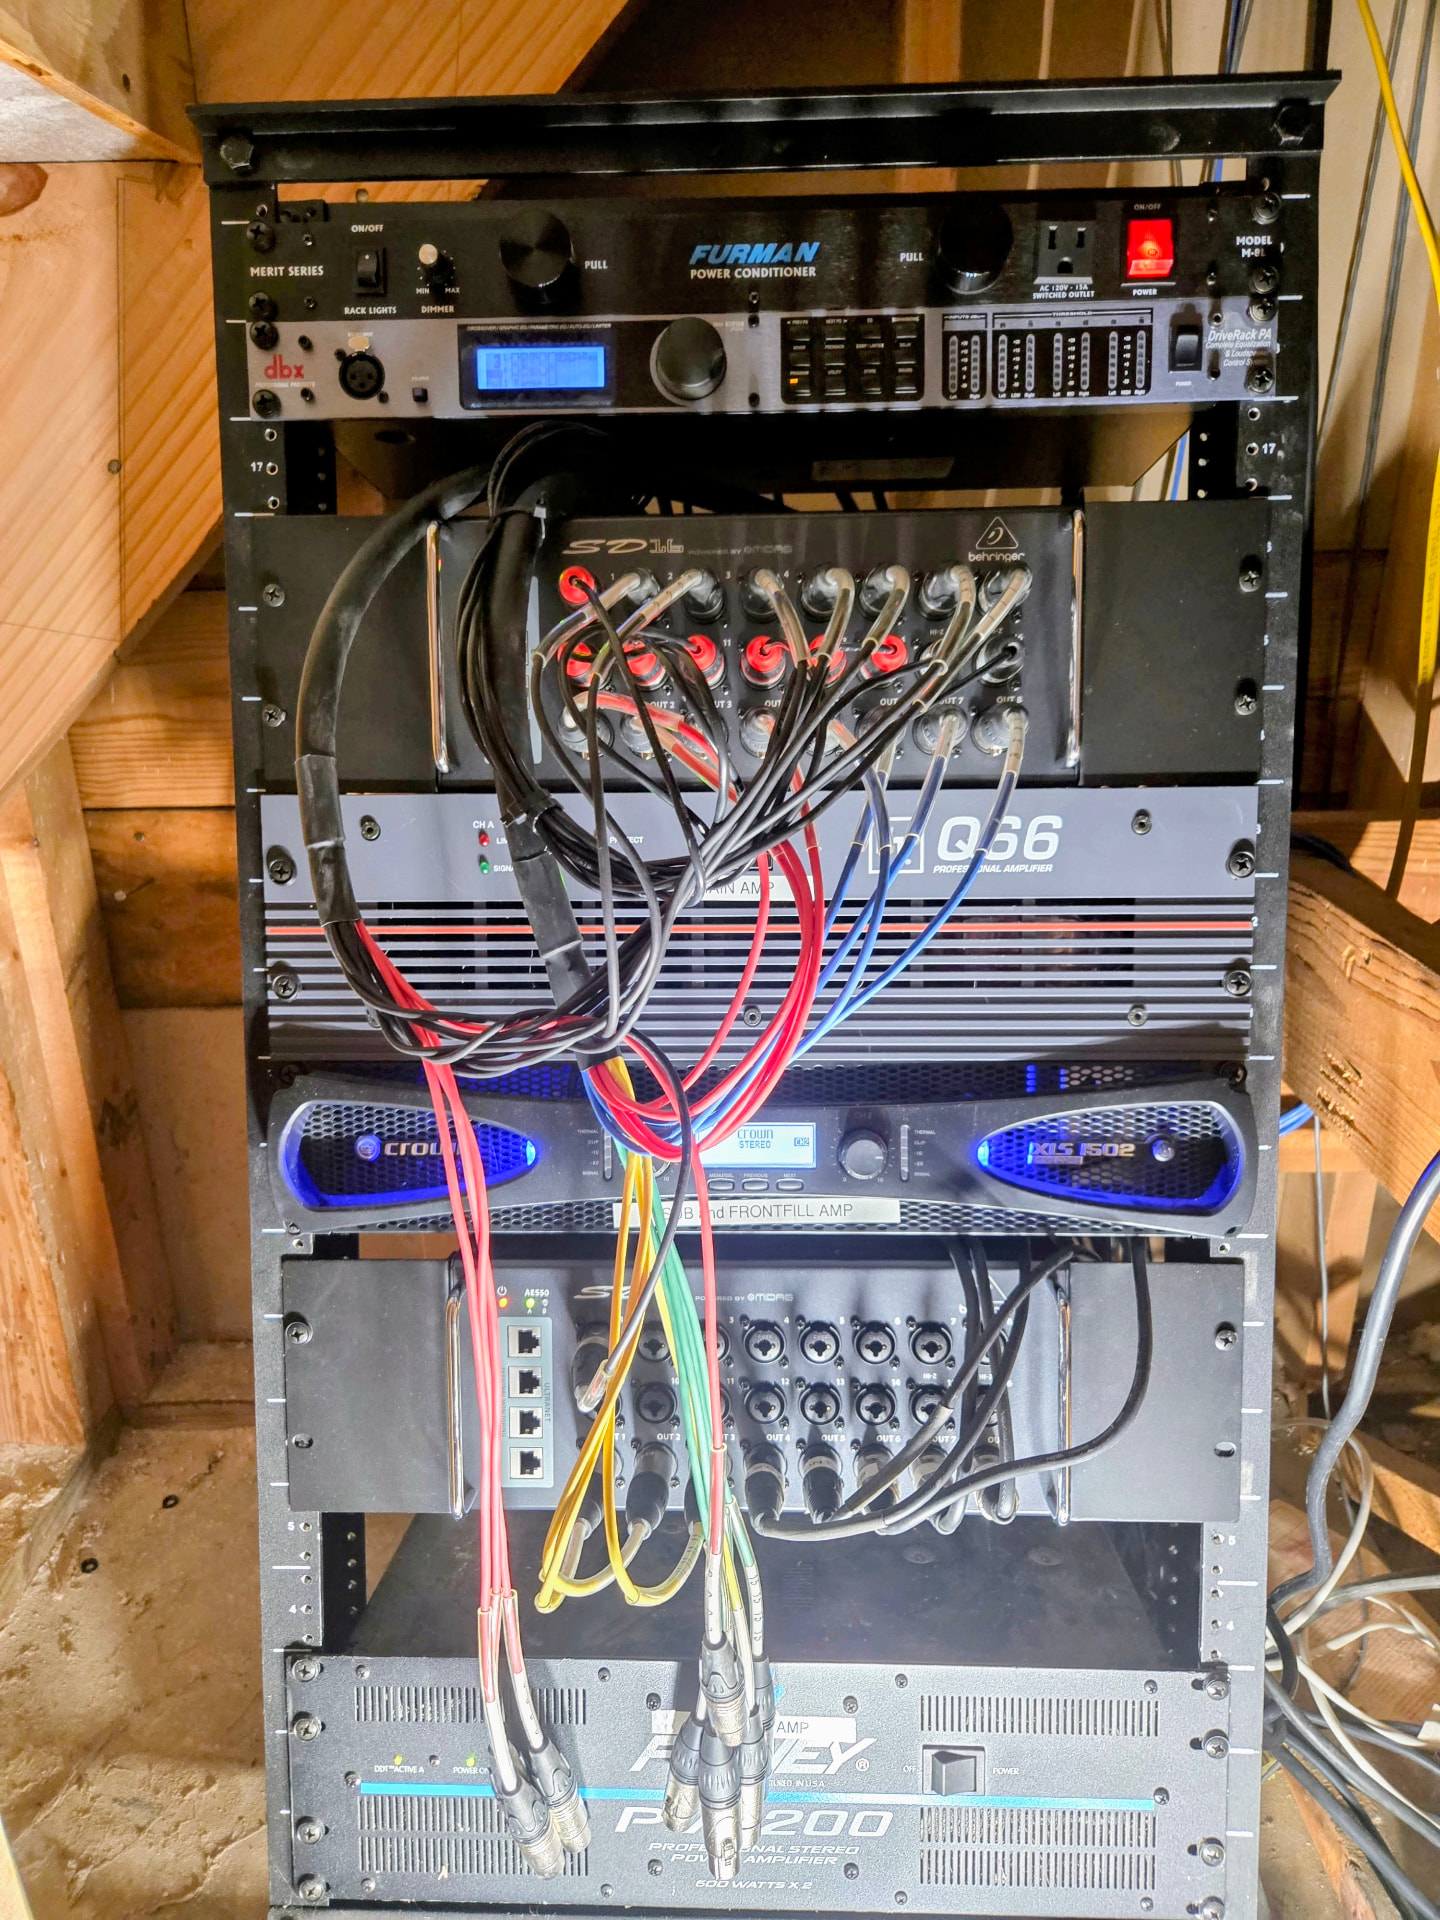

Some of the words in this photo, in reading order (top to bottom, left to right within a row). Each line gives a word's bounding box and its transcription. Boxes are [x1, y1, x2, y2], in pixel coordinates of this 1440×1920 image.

[1133, 203, 1161, 211] ON/OFF
[350, 224, 384, 233] ON/OFF
[1235, 235, 1272, 246] MODEL
[688, 241, 821, 266] FURMAN
[899, 252, 924, 263] PULL
[584, 260, 608, 270] PULL
[250, 266, 284, 277] MERIT
[288, 265, 324, 276] SERIES
[690, 268, 732, 280] POWER
[734, 266, 817, 279] CONDITIONER
[1039, 284, 1049, 292] AC
[1132, 288, 1158, 297] POWER
[1032, 291, 1068, 300] SWITCHED
[1068, 290, 1095, 299] OUTLET
[344, 306, 367, 315] RACK
[368, 305, 397, 315] LIGHTS
[421, 305, 455, 314] DIMMER
[1207, 329, 1257, 342] DriveRack
[1258, 328, 1272, 340] PA
[264, 354, 305, 379] dbx
[1261, 442, 1276, 454] 17
[250, 461, 263, 472] 17
[968, 551, 1026, 563] behringer
[610, 572, 615, 581] 1
[667, 572, 673, 580] 2
[725, 571, 731, 580] 3
[783, 571, 789, 579] 4
[722, 638, 732, 647] 11
[879, 698, 898, 706] OUT
[958, 697, 965, 705] 7
[996, 696, 1015, 704] OUT
[1016, 696, 1023, 704] 8
[651, 701, 669, 709] OUT
[669, 701, 675, 709] 2
[472, 820, 486, 829] CH
[487, 820, 495, 828] A
[937, 814, 1063, 862] Q66
[933, 864, 1002, 874] PROFESONAL
[1003, 863, 1053, 873] AMPLIFIER
[739, 1140, 771, 1149] STEREO
[793, 1137, 810, 1147] CH2
[384, 1142, 461, 1156] crow
[1032, 1142, 1074, 1156] XLS
[1078, 1142, 1136, 1157] 1502
[699, 1206, 724, 1219] nd
[729, 1204, 814, 1218] FRONTFILL
[819, 1203, 853, 1217] AMP
[524, 1288, 550, 1297] AES50
[783, 1316, 790, 1324] 4
[839, 1316, 845, 1324] 5
[950, 1317, 957, 1325] 7
[671, 1377, 680, 1385] 10
[727, 1377, 734, 1385] 11
[543, 1382, 551, 1423] ULTRANET
[821, 1434, 838, 1442] OUT
[950, 1435, 957, 1443] 7
[987, 1436, 1000, 1444] OU
[287, 1522, 295, 1531] 5
[776, 1721, 809, 1734] AMP
[417, 1766, 425, 1774] A
[903, 1764, 917, 1773] OFF
[992, 1767, 1020, 1775] POWER
[789, 1845, 860, 1855] STEREO
[743, 1855, 838, 1865] AMPLIFIER
[695, 1880, 730, 1889] 600
[731, 1880, 786, 1889] WATTS
[788, 1881, 799, 1889] X
[801, 1881, 813, 1890] 2
